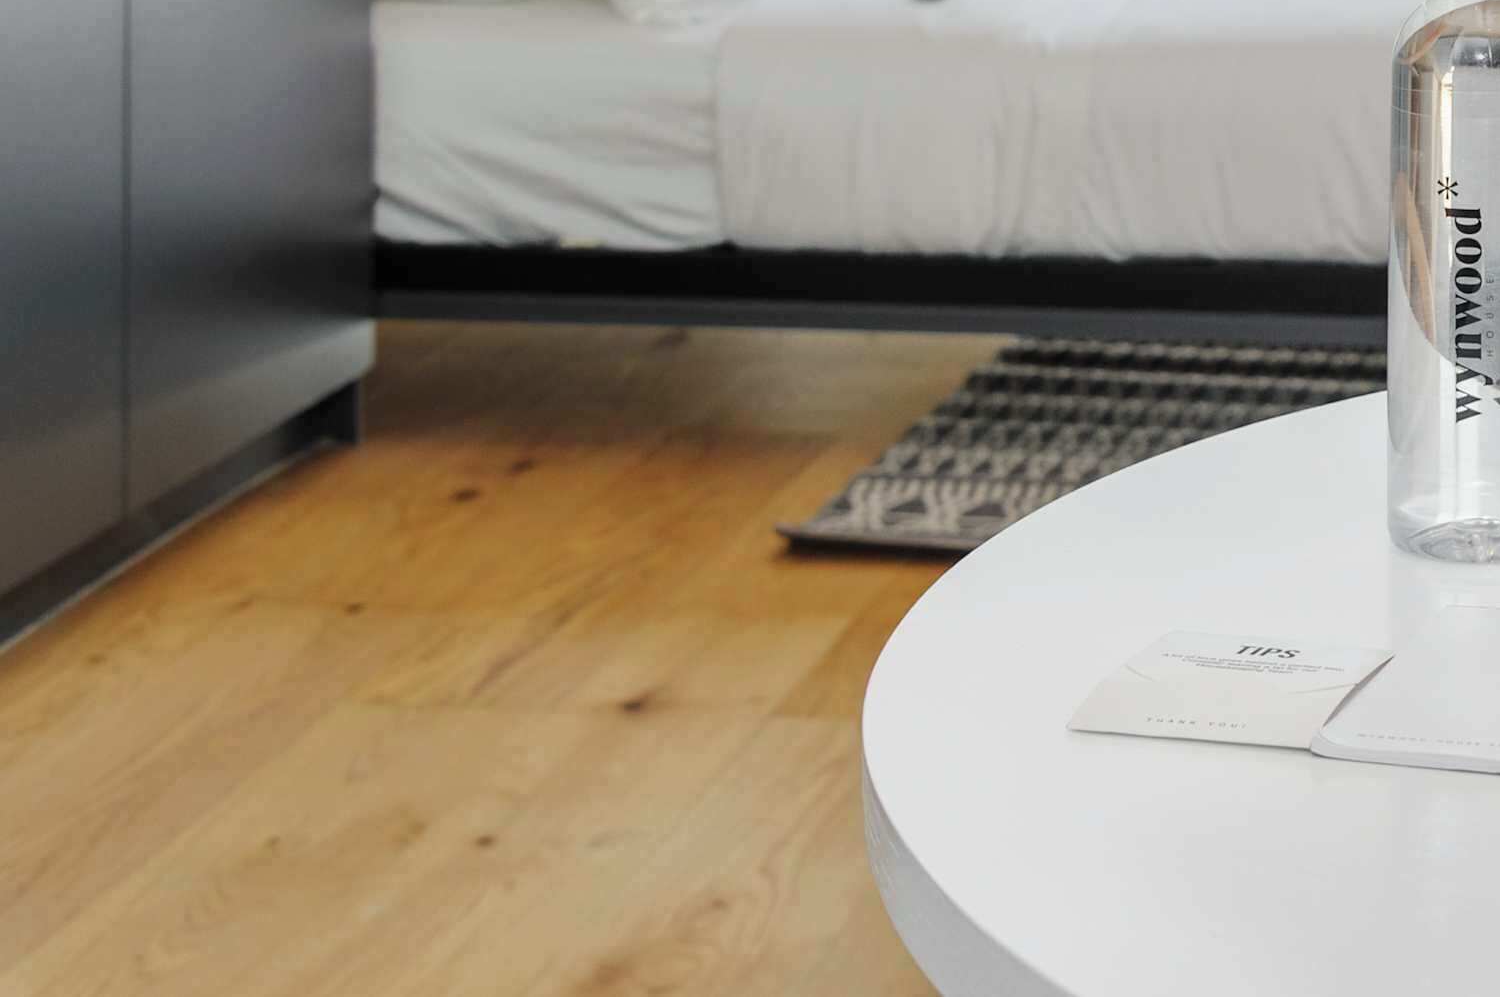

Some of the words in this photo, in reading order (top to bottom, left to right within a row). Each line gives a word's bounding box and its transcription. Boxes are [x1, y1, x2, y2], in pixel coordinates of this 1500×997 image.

[1445, 208, 1493, 423] wynwood
[1486, 277, 1495, 357] HOUSE
[1236, 645, 1301, 659] TIPS
